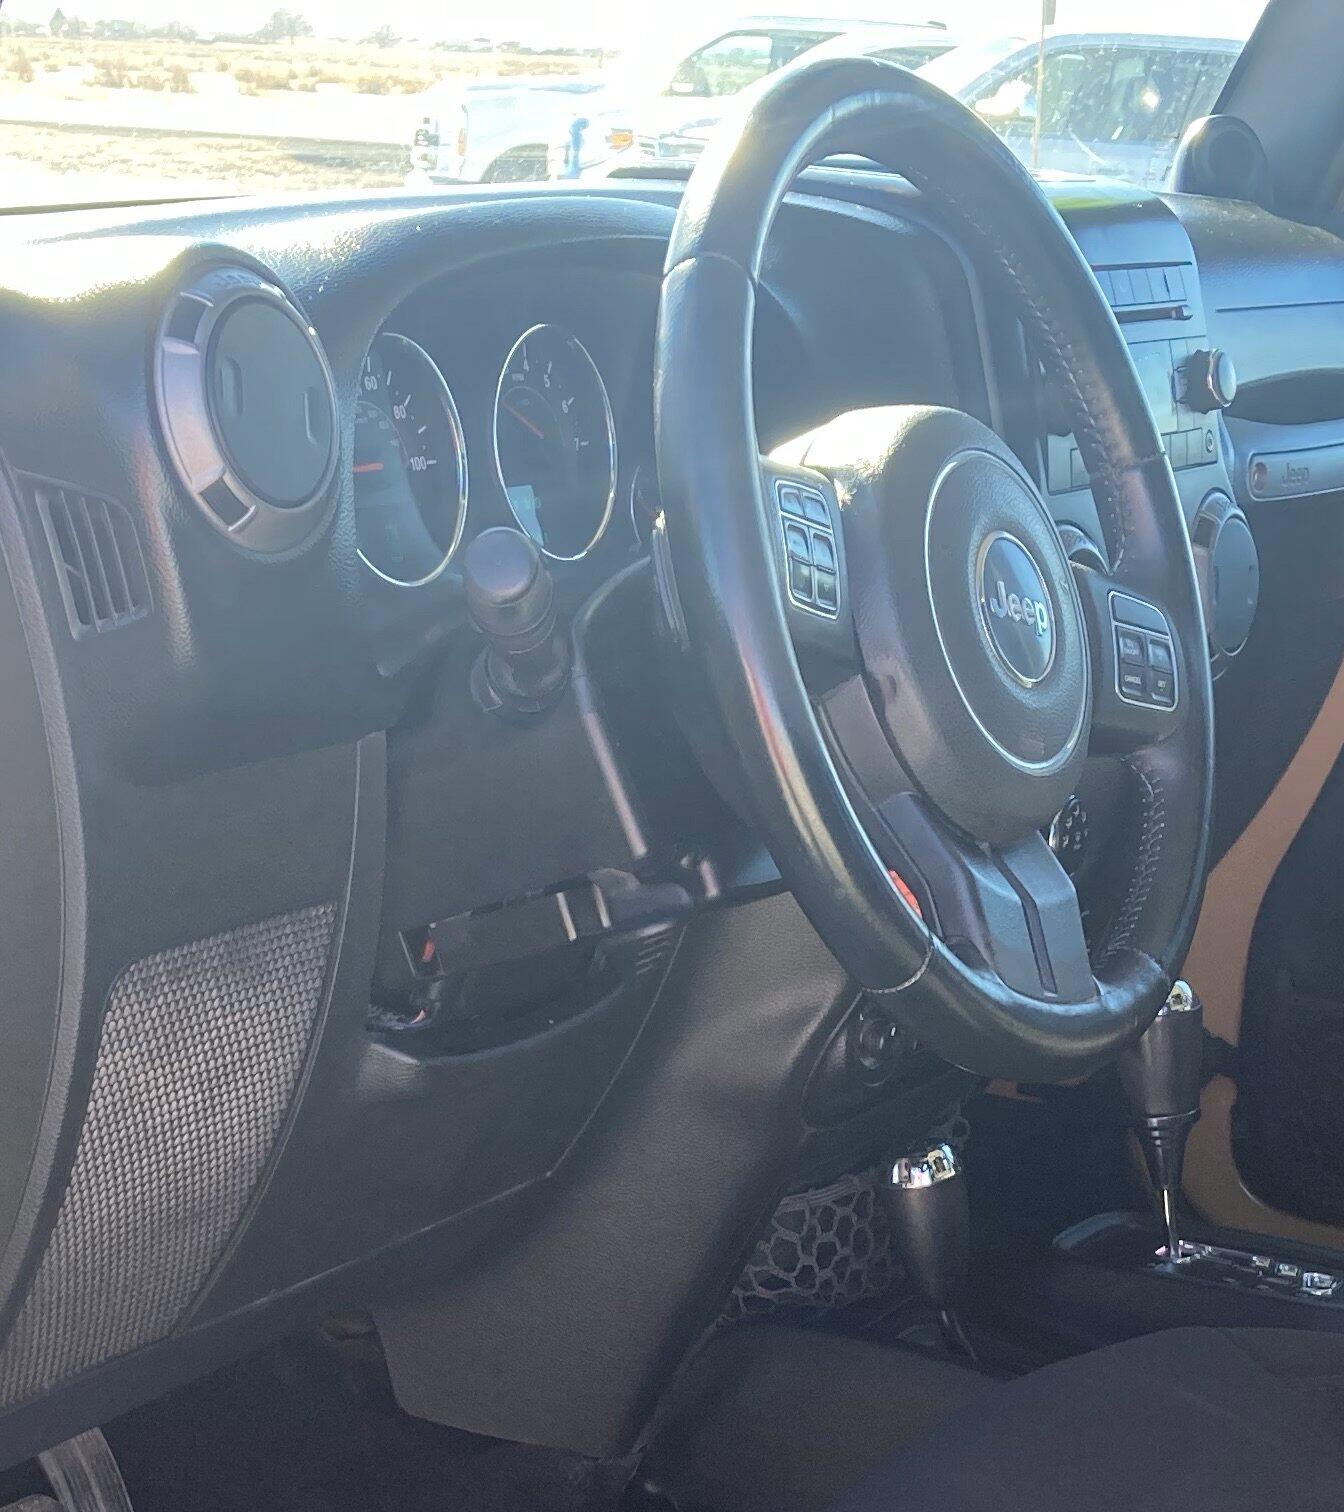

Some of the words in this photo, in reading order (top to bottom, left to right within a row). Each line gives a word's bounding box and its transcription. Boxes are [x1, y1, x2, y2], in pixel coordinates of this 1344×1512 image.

[364, 375, 377, 390] 60
[543, 373, 550, 387] 5
[393, 405, 406, 419] 80
[562, 401, 568, 413] 6
[409, 456, 427, 471] 100
[990, 580, 1047, 636] Jeep
